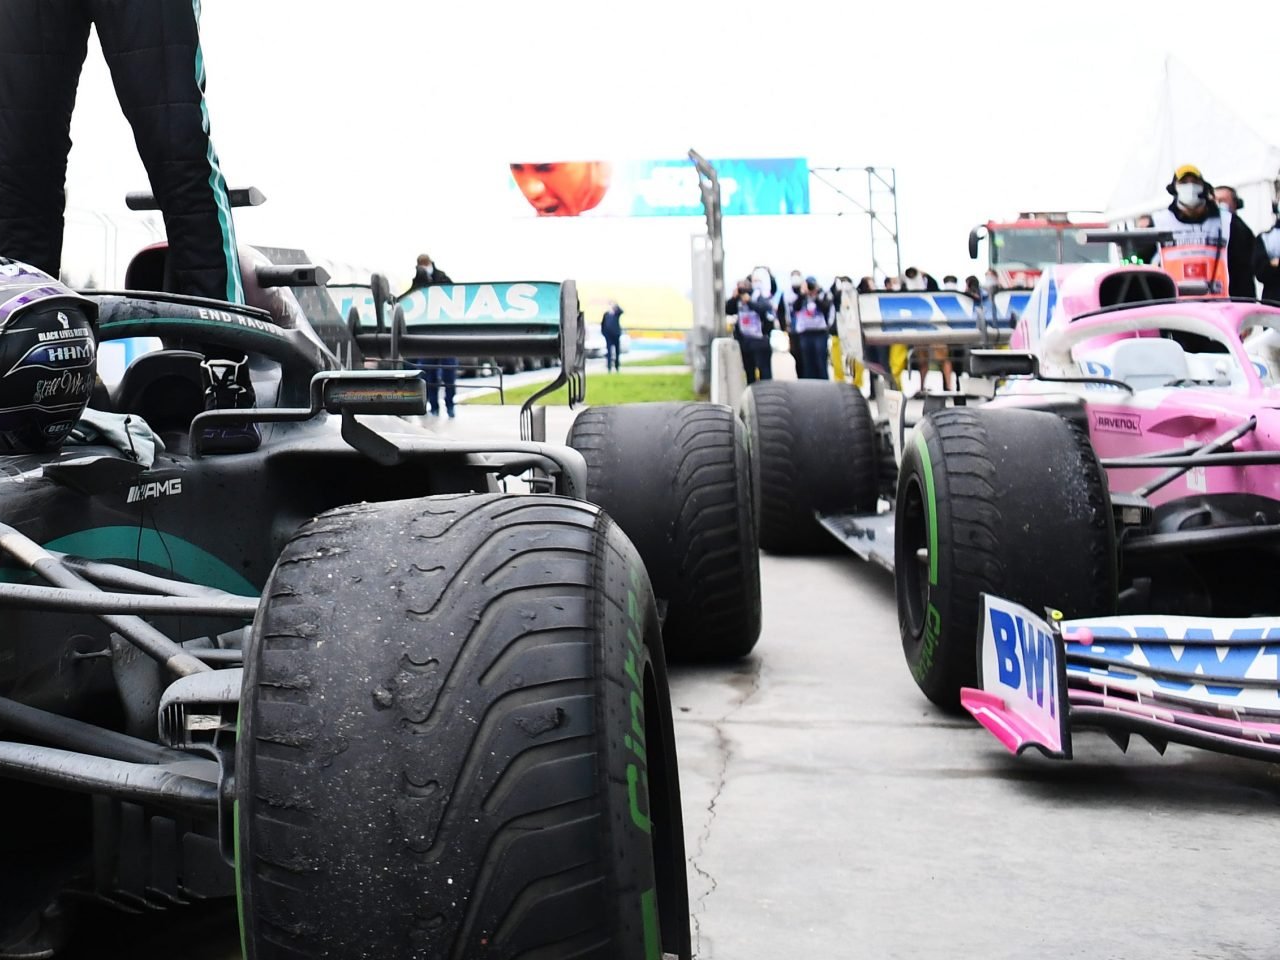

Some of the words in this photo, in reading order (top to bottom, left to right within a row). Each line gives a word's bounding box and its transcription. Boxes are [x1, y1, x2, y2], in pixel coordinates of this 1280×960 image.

[199, 308, 233, 323] END
[38, 330, 60, 341] BLACK
[59, 329, 75, 340] LIVES
[48, 346, 90, 361] HAM
[48, 423, 69, 433] BELL
[1098, 417, 1139, 430] RAVENOL
[144, 478, 182, 500] AMG
[990, 608, 1055, 720] BWT
